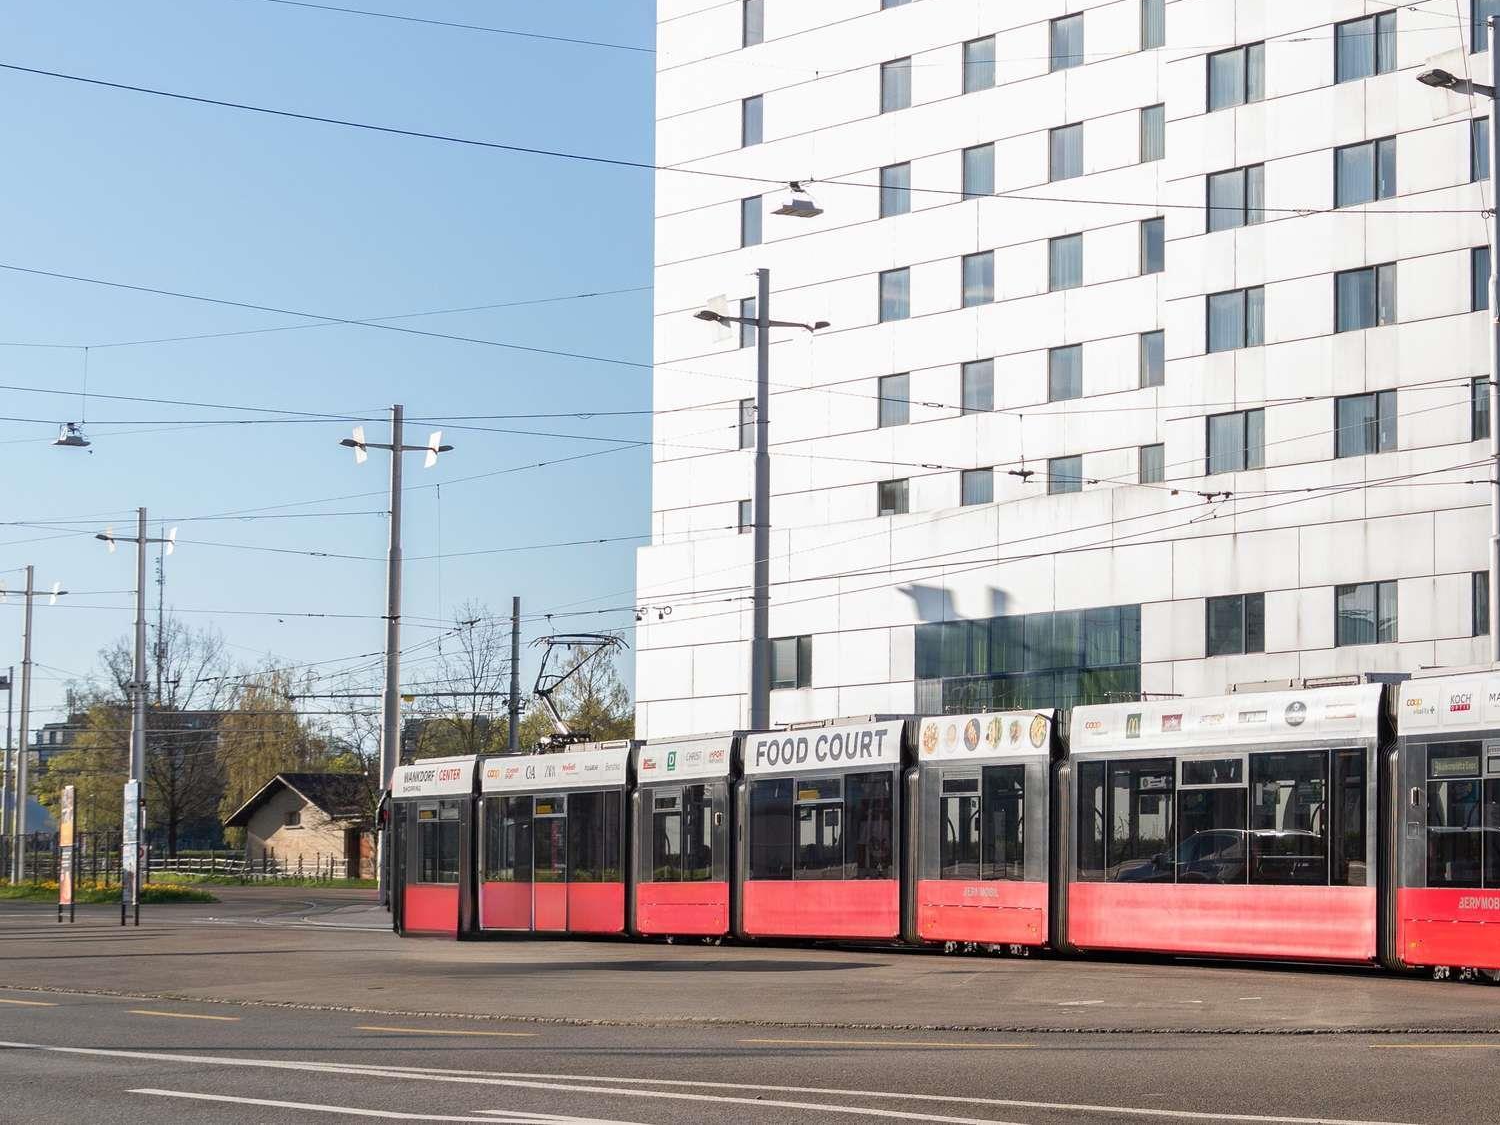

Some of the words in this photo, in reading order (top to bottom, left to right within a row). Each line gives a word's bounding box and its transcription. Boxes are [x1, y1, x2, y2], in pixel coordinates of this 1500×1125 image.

[1450, 693, 1472, 704] KOCH
[756, 737, 808, 766] FOOD
[815, 729, 888, 762] COURT
[439, 768, 462, 781] CENTER
